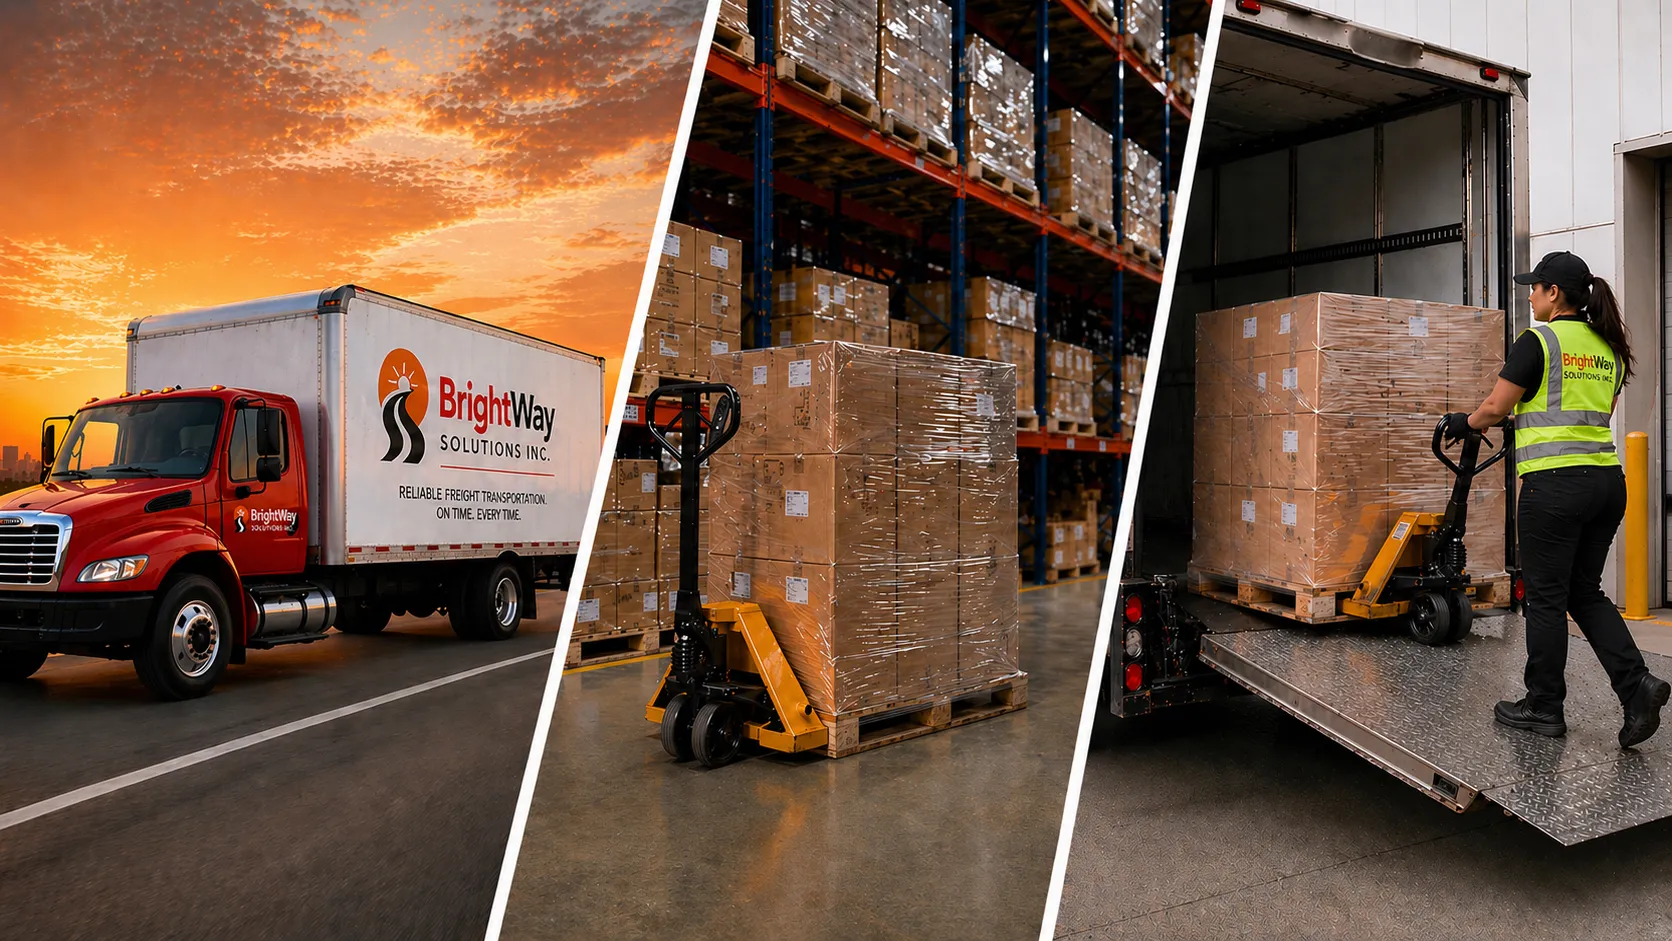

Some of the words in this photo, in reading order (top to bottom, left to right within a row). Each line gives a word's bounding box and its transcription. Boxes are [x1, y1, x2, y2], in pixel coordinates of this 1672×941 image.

[1563, 352, 1614, 375] BrightWay
[1564, 371, 1600, 380] SOLUTIONS
[439, 376, 556, 442] BrightWay
[440, 434, 521, 458] SOLUTIONS
[526, 445, 551, 462] INC.
[399, 485, 442, 500] RELIABLE
[445, 490, 480, 503] FREIGHT
[482, 491, 548, 505] TRANSPORTATION.
[251, 508, 297, 525] BrightWay
[436, 506, 450, 520] ON
[452, 507, 475, 521] TIME.
[477, 508, 500, 521] EVERY
[502, 509, 522, 521] TIME.
